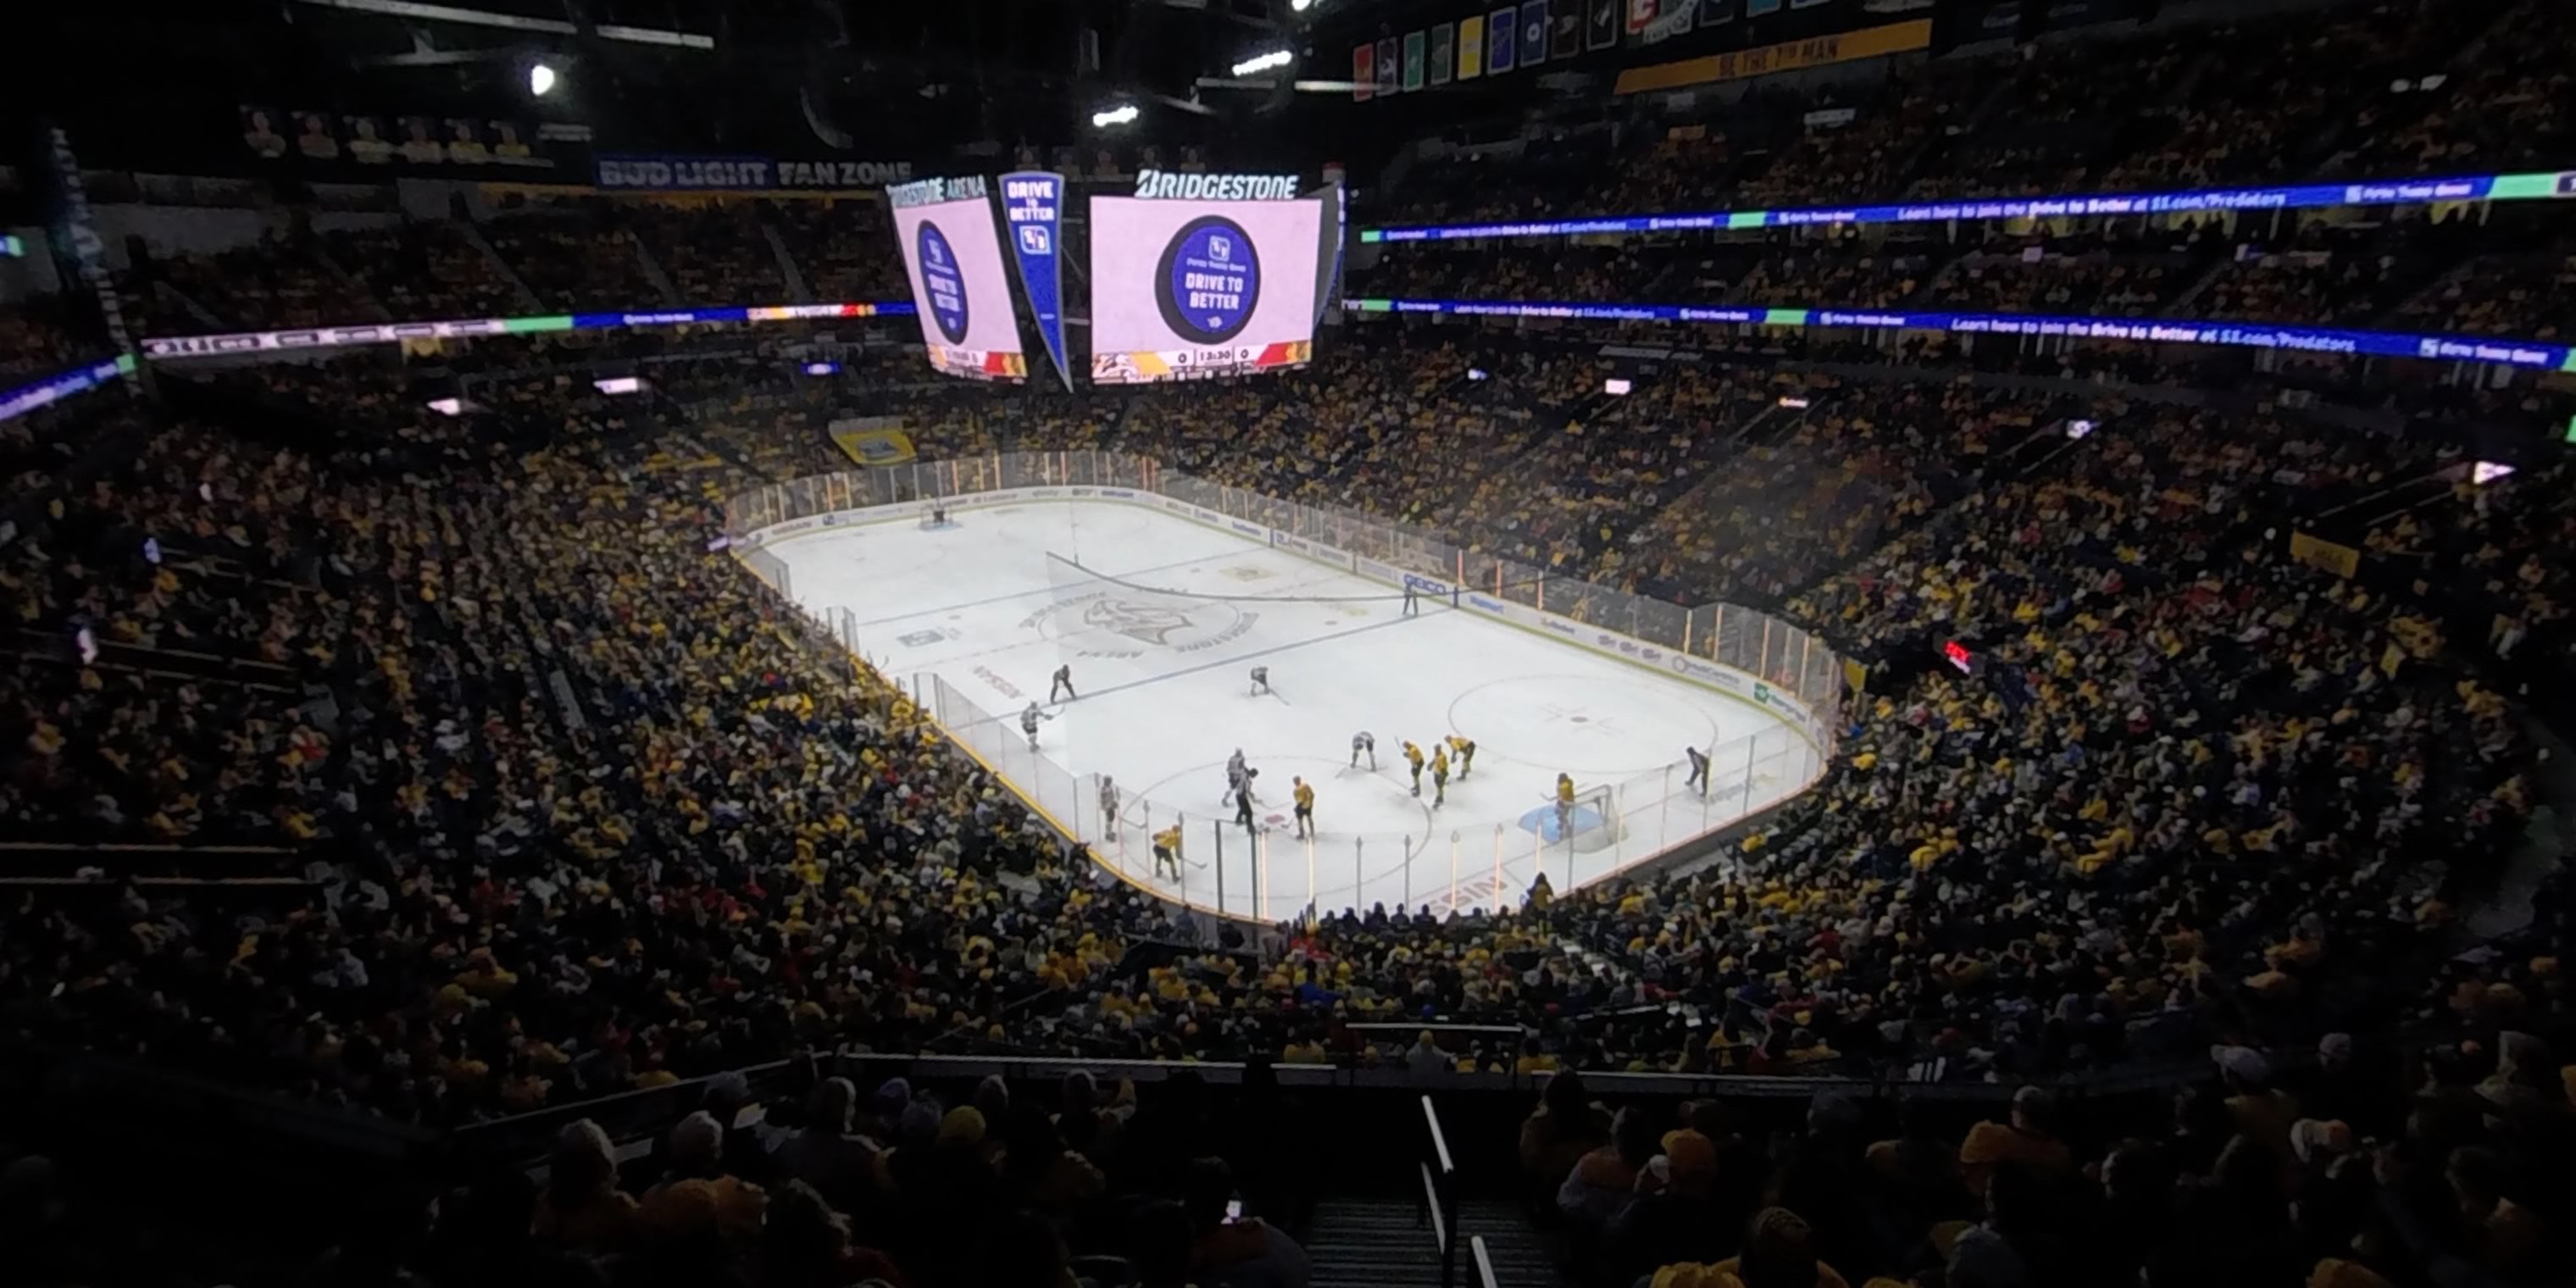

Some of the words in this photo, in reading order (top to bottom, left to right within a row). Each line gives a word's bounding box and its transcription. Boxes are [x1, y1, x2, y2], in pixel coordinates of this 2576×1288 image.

[1742, 51, 1768, 74] THE
[1801, 39, 1839, 64] MAN
[598, 160, 671, 186] BUD
[675, 160, 768, 186] LIGHT
[776, 161, 834, 186] FAN
[838, 160, 912, 185] ZONE
[1008, 180, 1053, 199] DRIVE
[1135, 169, 1299, 199] BRIDGESTONE
[1010, 207, 1055, 222] BETTER
[1185, 272, 1226, 291] DRIVE
[1226, 276, 1244, 292] TO
[1189, 291, 1240, 310] BETTER
[1951, 319, 1989, 331] Learn
[1991, 319, 2019, 332] how
[2022, 321, 2038, 333] to
[2091, 323, 2128, 337] Drive
[2131, 325, 2146, 338] to
[2151, 325, 2198, 341] Better
[1178, 353, 1188, 364] 0
[1240, 348, 1249, 359] 0
